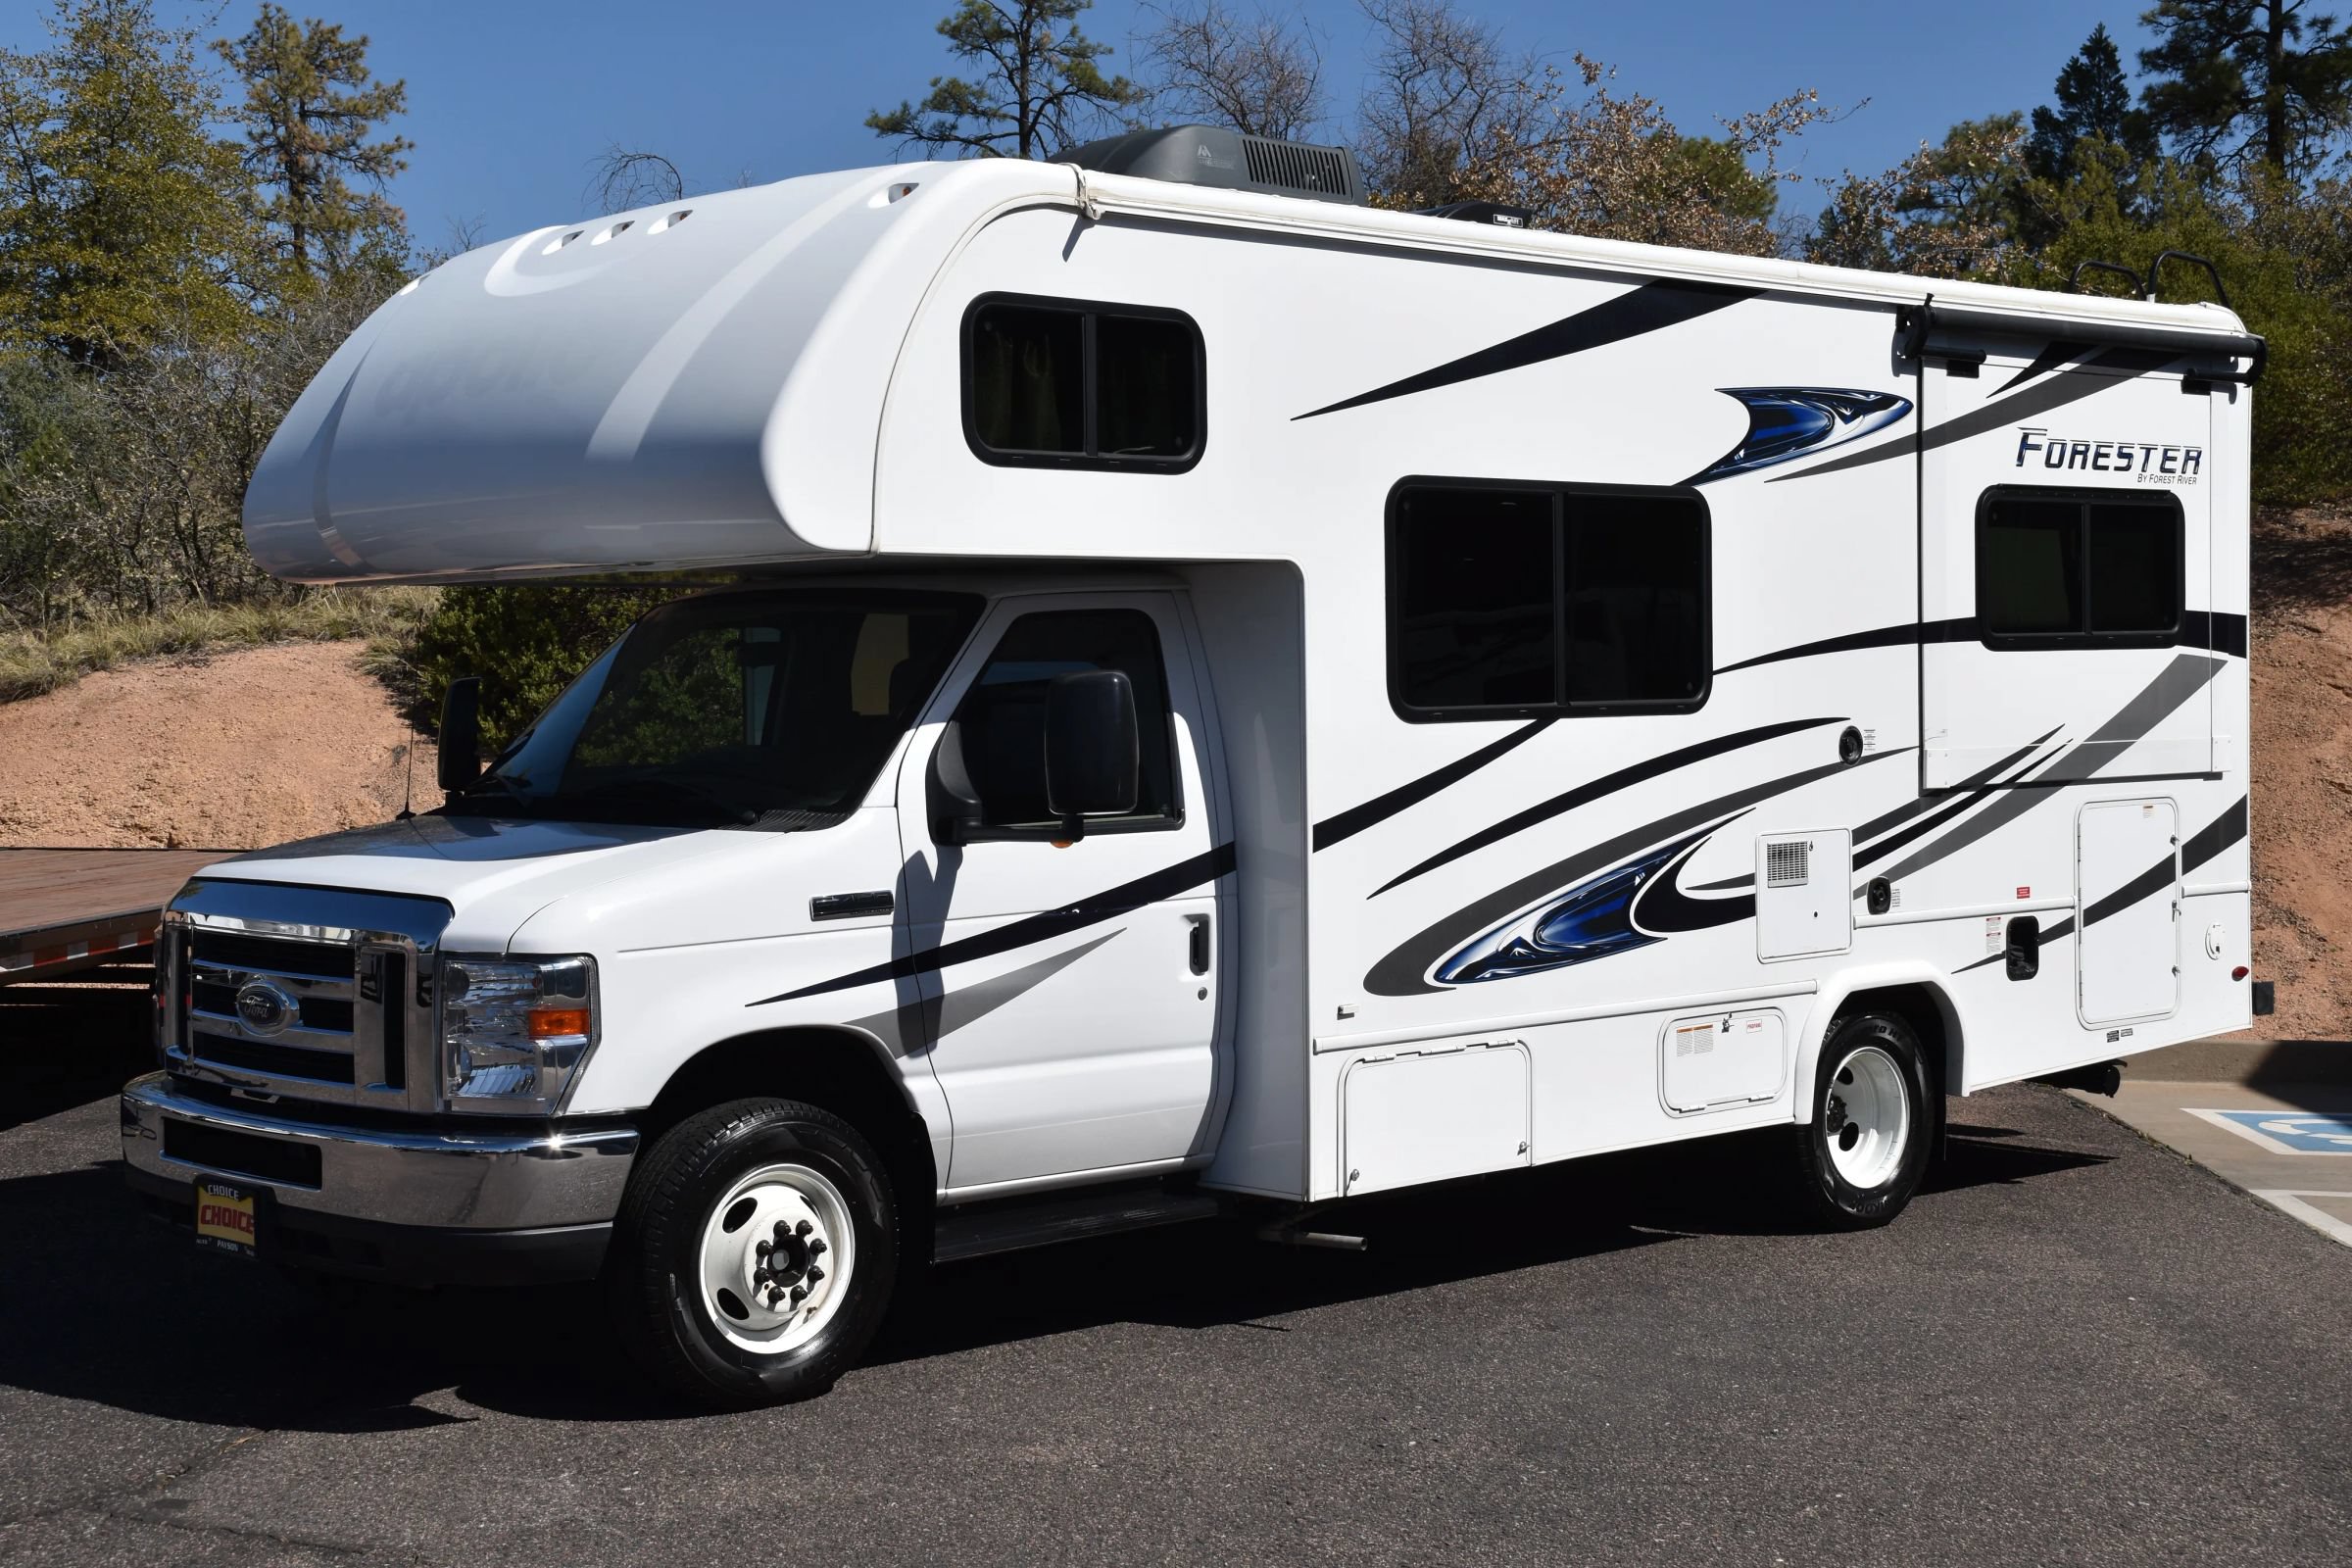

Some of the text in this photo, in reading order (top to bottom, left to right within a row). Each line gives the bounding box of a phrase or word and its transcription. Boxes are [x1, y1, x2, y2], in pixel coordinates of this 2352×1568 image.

[2016, 427, 2203, 474] FORESTER
[2137, 473, 2197, 485] BY FOREST RIVER
[208, 1184, 239, 1200] CHOICE
[200, 1204, 255, 1235] CHOICE
